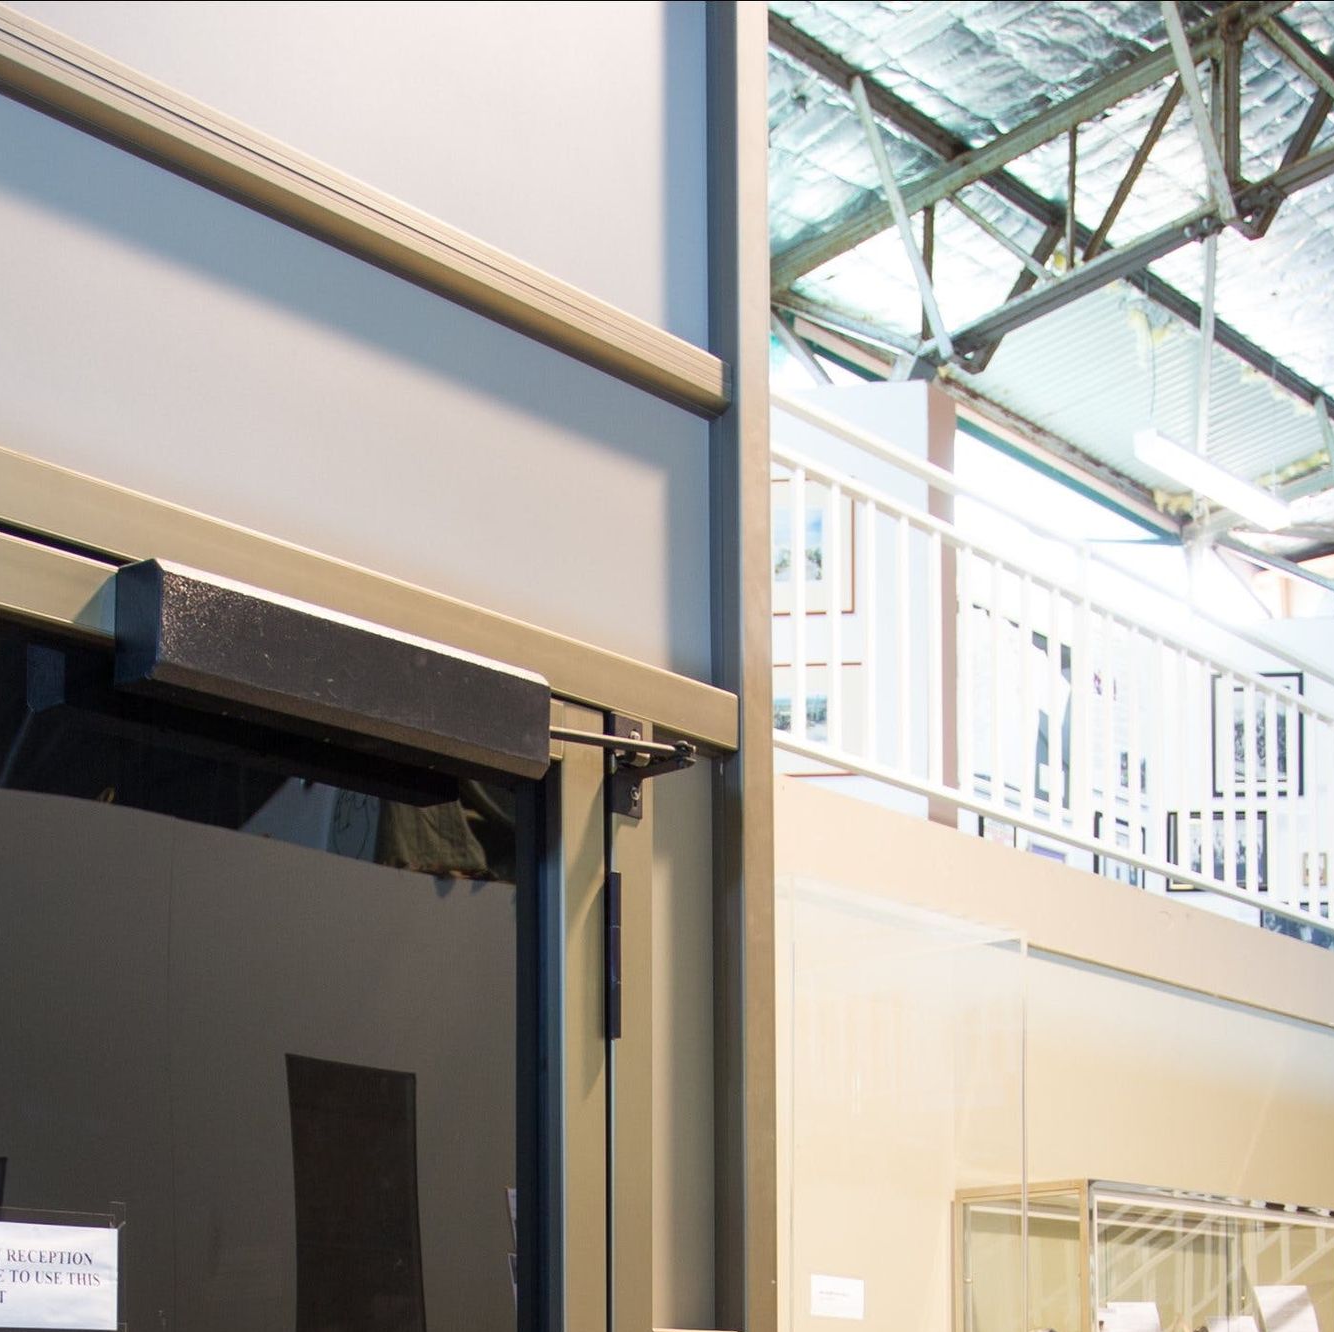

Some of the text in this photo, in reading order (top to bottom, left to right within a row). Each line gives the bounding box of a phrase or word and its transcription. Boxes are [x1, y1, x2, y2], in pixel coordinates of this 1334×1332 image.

[7, 1248, 93, 1265] RECEPTION
[10, 1269, 31, 1283] TO
[35, 1270, 63, 1285] USE
[66, 1271, 101, 1287] THIS
